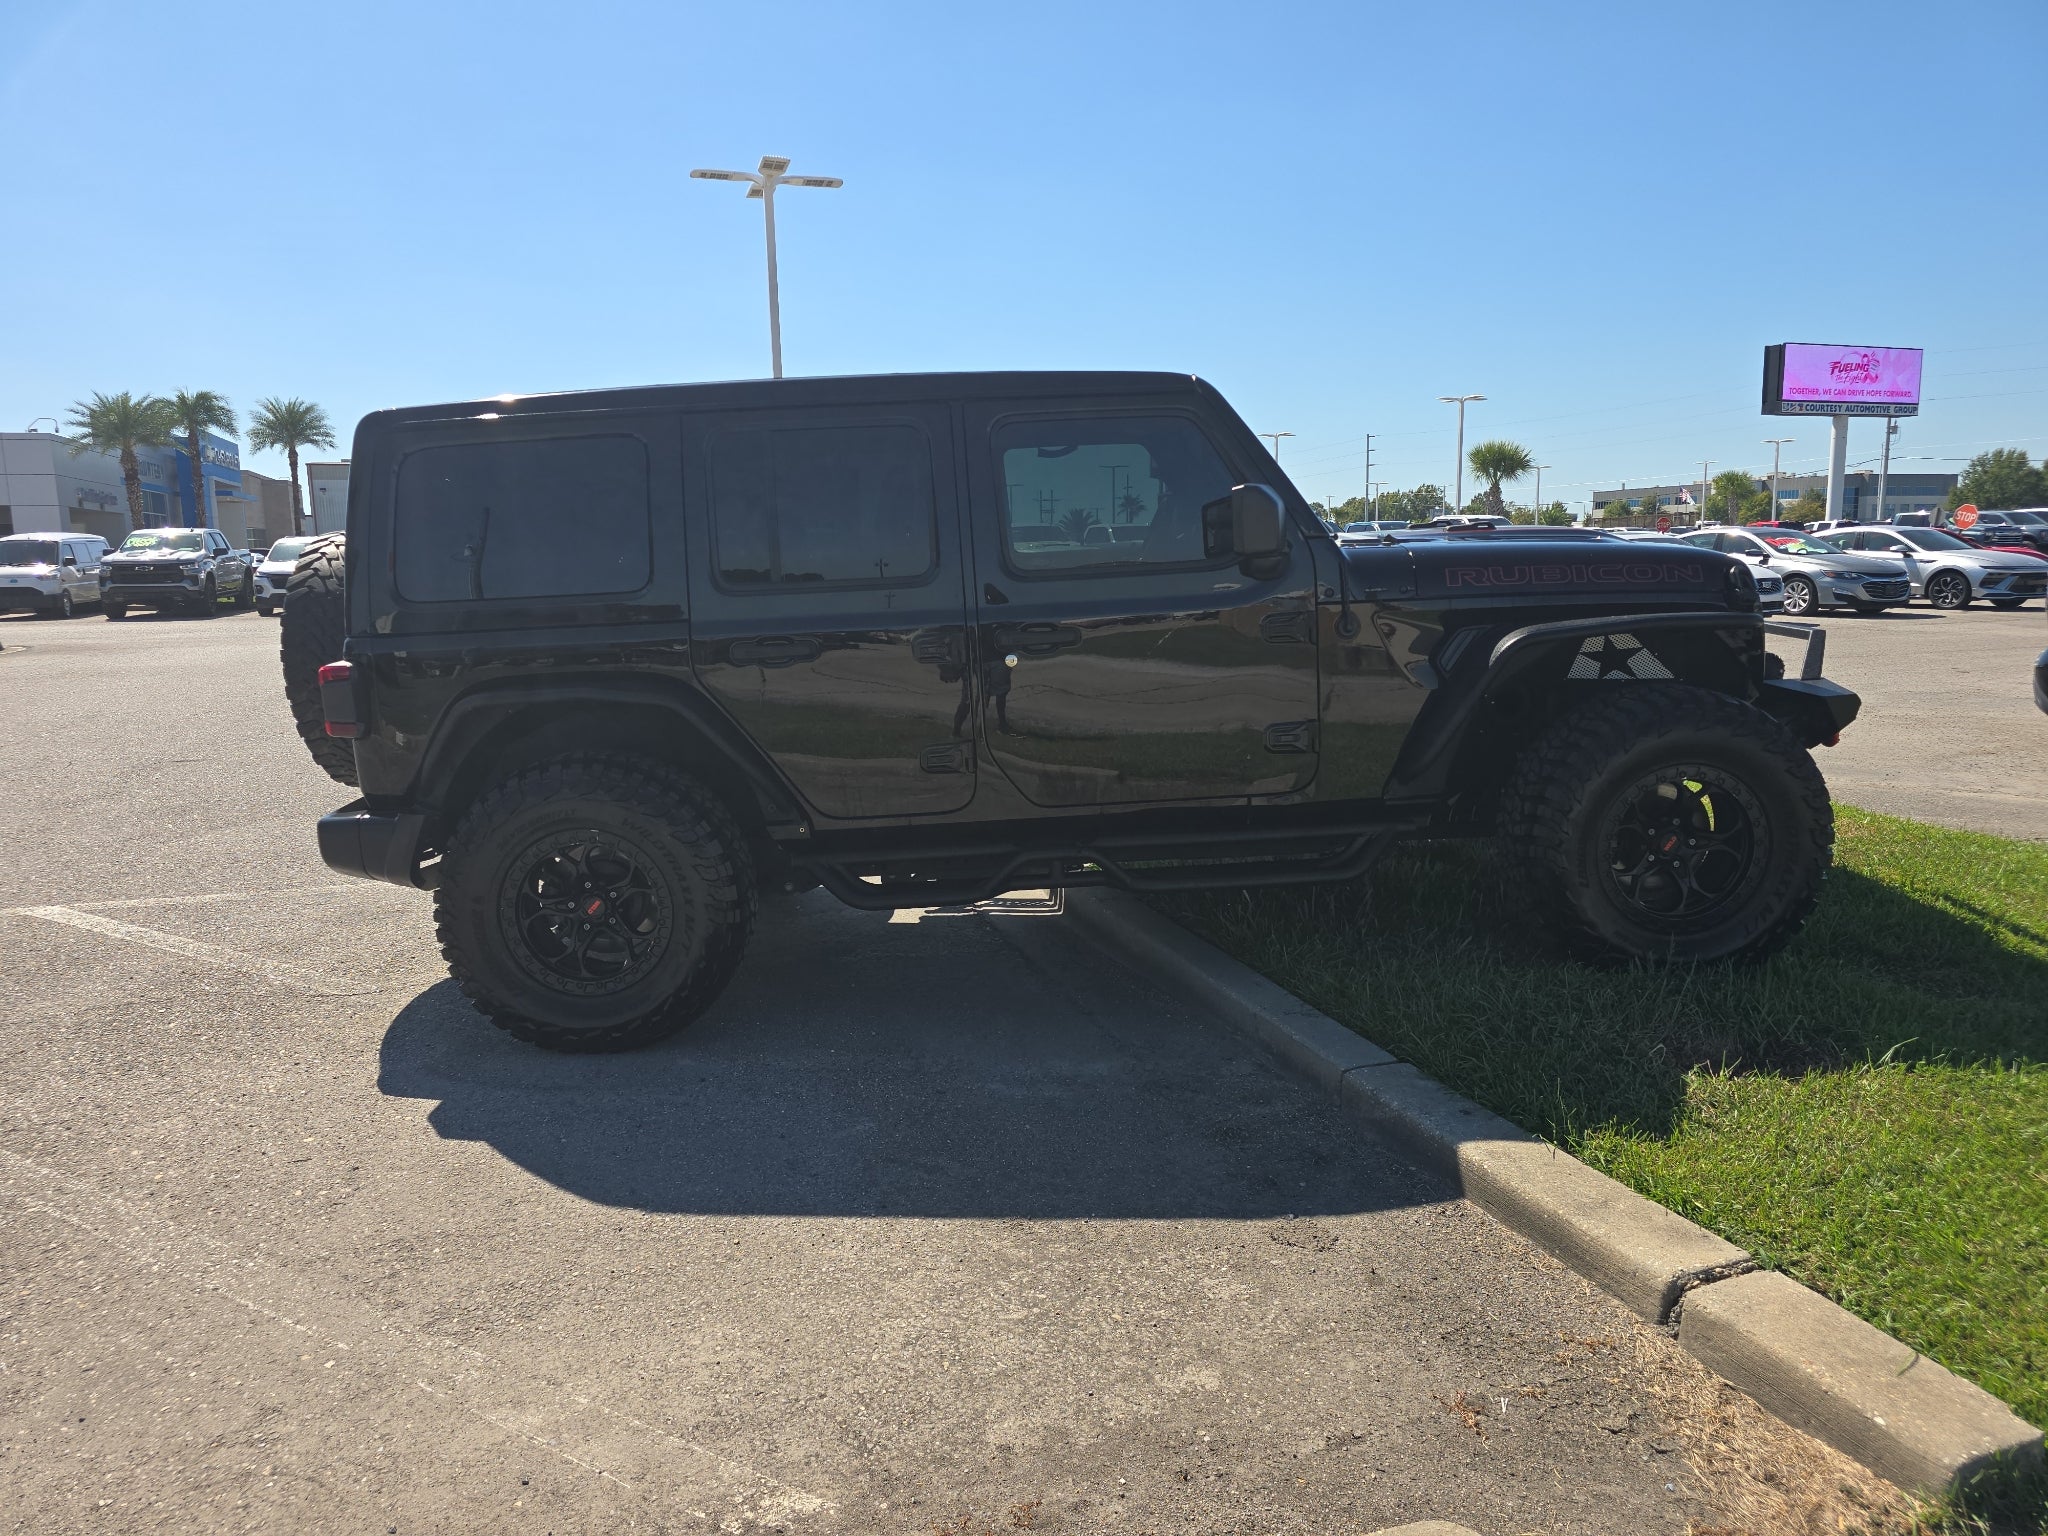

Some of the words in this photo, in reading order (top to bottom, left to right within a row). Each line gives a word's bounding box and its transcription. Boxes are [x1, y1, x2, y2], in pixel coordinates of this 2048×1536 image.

[1829, 361, 1871, 375] FUELING
[1789, 388, 1821, 397] TOGETHER,
[1822, 388, 1832, 396] WE
[1833, 388, 1847, 396] CAN
[1848, 389, 1865, 397] DRIVE
[1866, 389, 1882, 397] HOPE
[1883, 389, 1913, 398] FORWARD.
[1805, 403, 1842, 413] COURTESY
[1845, 404, 1891, 414] AUTOMOTIVE
[1894, 405, 1918, 414] GROUP
[1955, 510, 1976, 523] STOP
[1658, 521, 1671, 529] STOP
[1444, 563, 1704, 587] RUBICON
